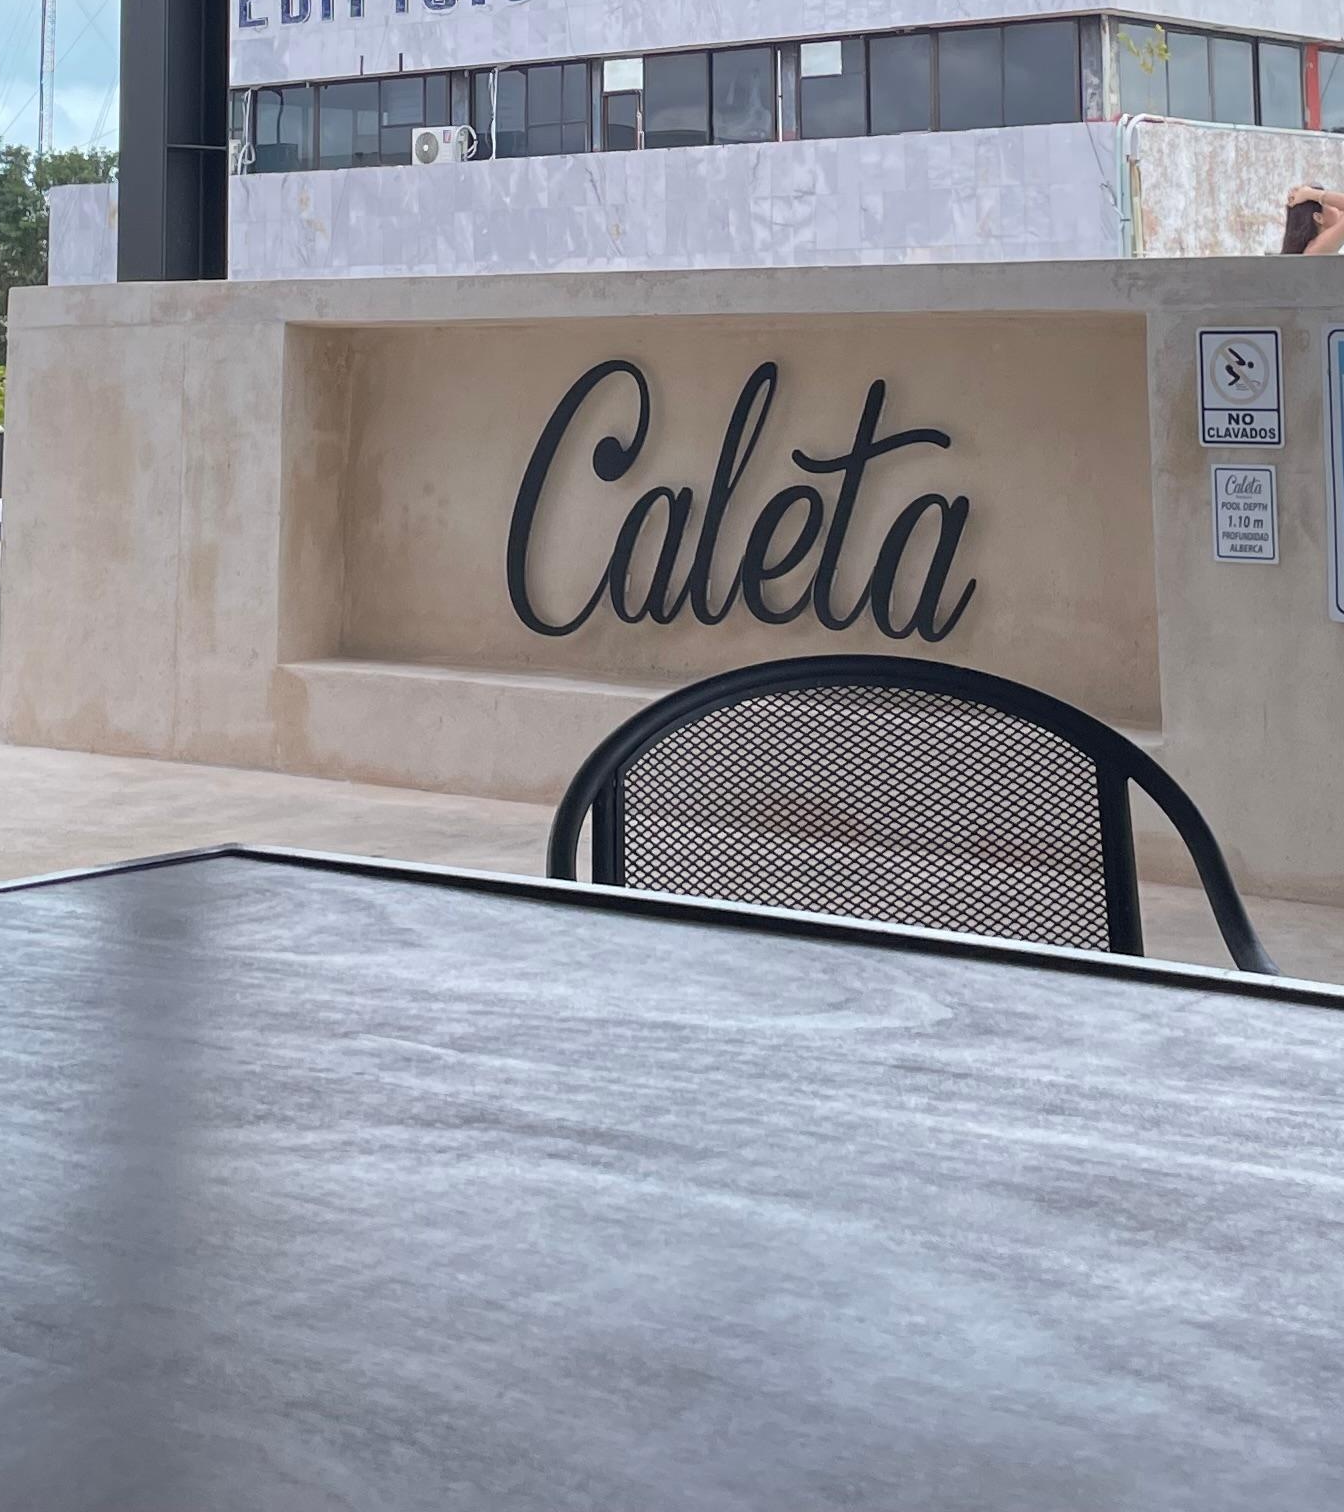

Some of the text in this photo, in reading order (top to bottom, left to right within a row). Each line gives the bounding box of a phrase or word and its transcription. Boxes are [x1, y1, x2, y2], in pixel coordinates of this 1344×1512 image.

[1228, 413, 1254, 425] NO
[1207, 427, 1276, 440] CLAVADOS
[1225, 474, 1262, 495] Caleta
[506, 359, 977, 643] Caleta
[1222, 502, 1268, 512] POOL DEPTH
[1228, 515, 1263, 528] 1.10 m
[1230, 543, 1263, 553] ALBERCA
